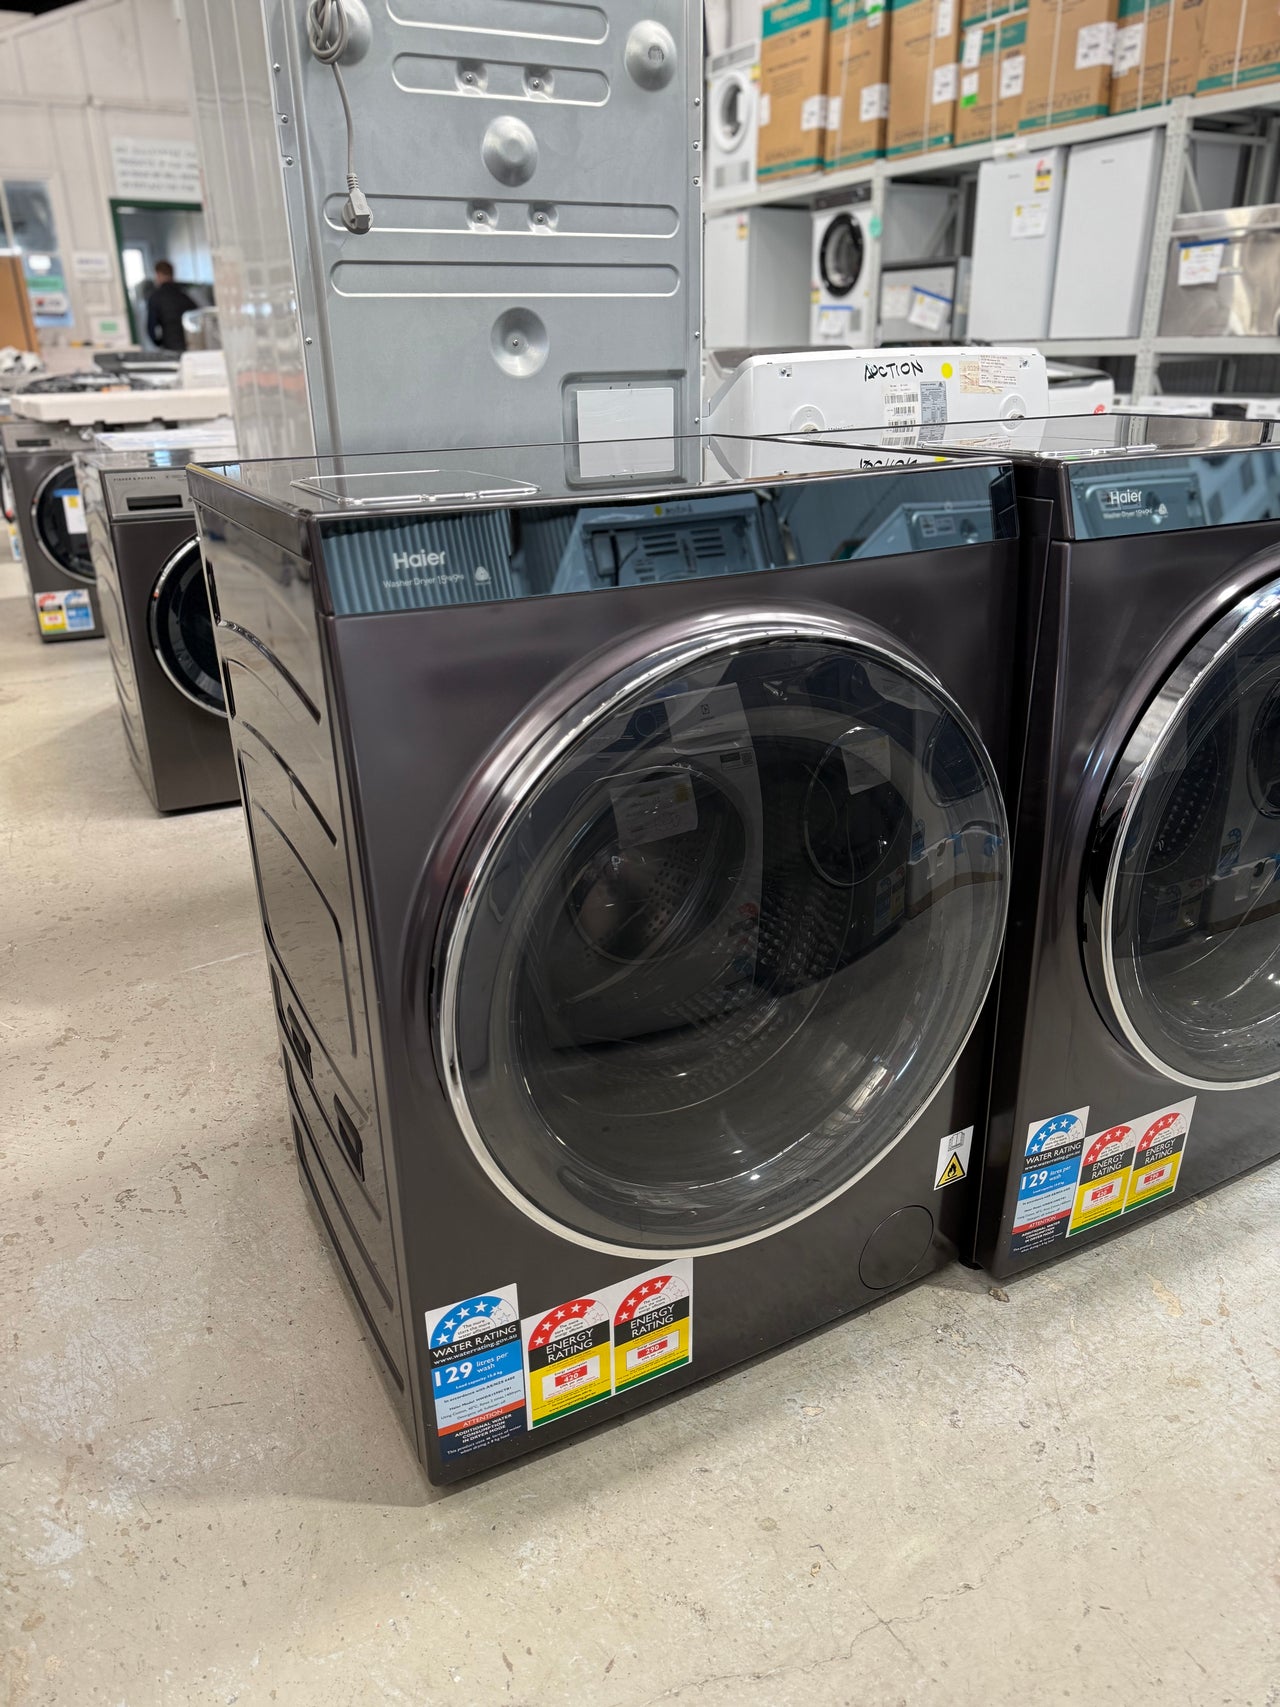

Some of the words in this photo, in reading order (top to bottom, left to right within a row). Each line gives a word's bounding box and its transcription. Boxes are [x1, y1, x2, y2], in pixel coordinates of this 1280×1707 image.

[864, 359, 924, 382] AUCTION
[1110, 489, 1142, 505] Haier
[392, 548, 446, 570] Haier
[382, 579, 413, 589] Washer
[413, 577, 435, 587] Dryer
[1026, 1152, 1053, 1165] WATER
[1053, 1141, 1082, 1156] RATING
[1144, 1148, 1173, 1165] RATING
[1145, 1138, 1176, 1156] ENERGY
[1091, 1161, 1122, 1180] RATING
[1092, 1152, 1125, 1171] ENERGY
[1021, 1170, 1049, 1190] 129
[1028, 1215, 1057, 1229] ATTENTION
[630, 1303, 675, 1329] ENERGY
[631, 1314, 674, 1338] RATING
[432, 1340, 473, 1358] WATER
[475, 1324, 517, 1346] RATING
[433, 1333, 518, 1366] www.waterrating.gov.au
[546, 1328, 594, 1354] ENERGY
[547, 1338, 593, 1363] RATING
[645, 1344, 660, 1354] 290
[476, 1356, 495, 1367] litres
[496, 1351, 509, 1362] per
[476, 1363, 496, 1374] wash
[434, 1361, 473, 1388] 129
[564, 1372, 579, 1383] 420
[454, 1421, 491, 1438] ADDITIONAL
[491, 1413, 512, 1424] WATER
[462, 1409, 503, 1427] ATTENTION
[462, 1420, 506, 1439] CONSUMPTION
[469, 1431, 489, 1442] DRYER
[488, 1424, 506, 1435] MODE
